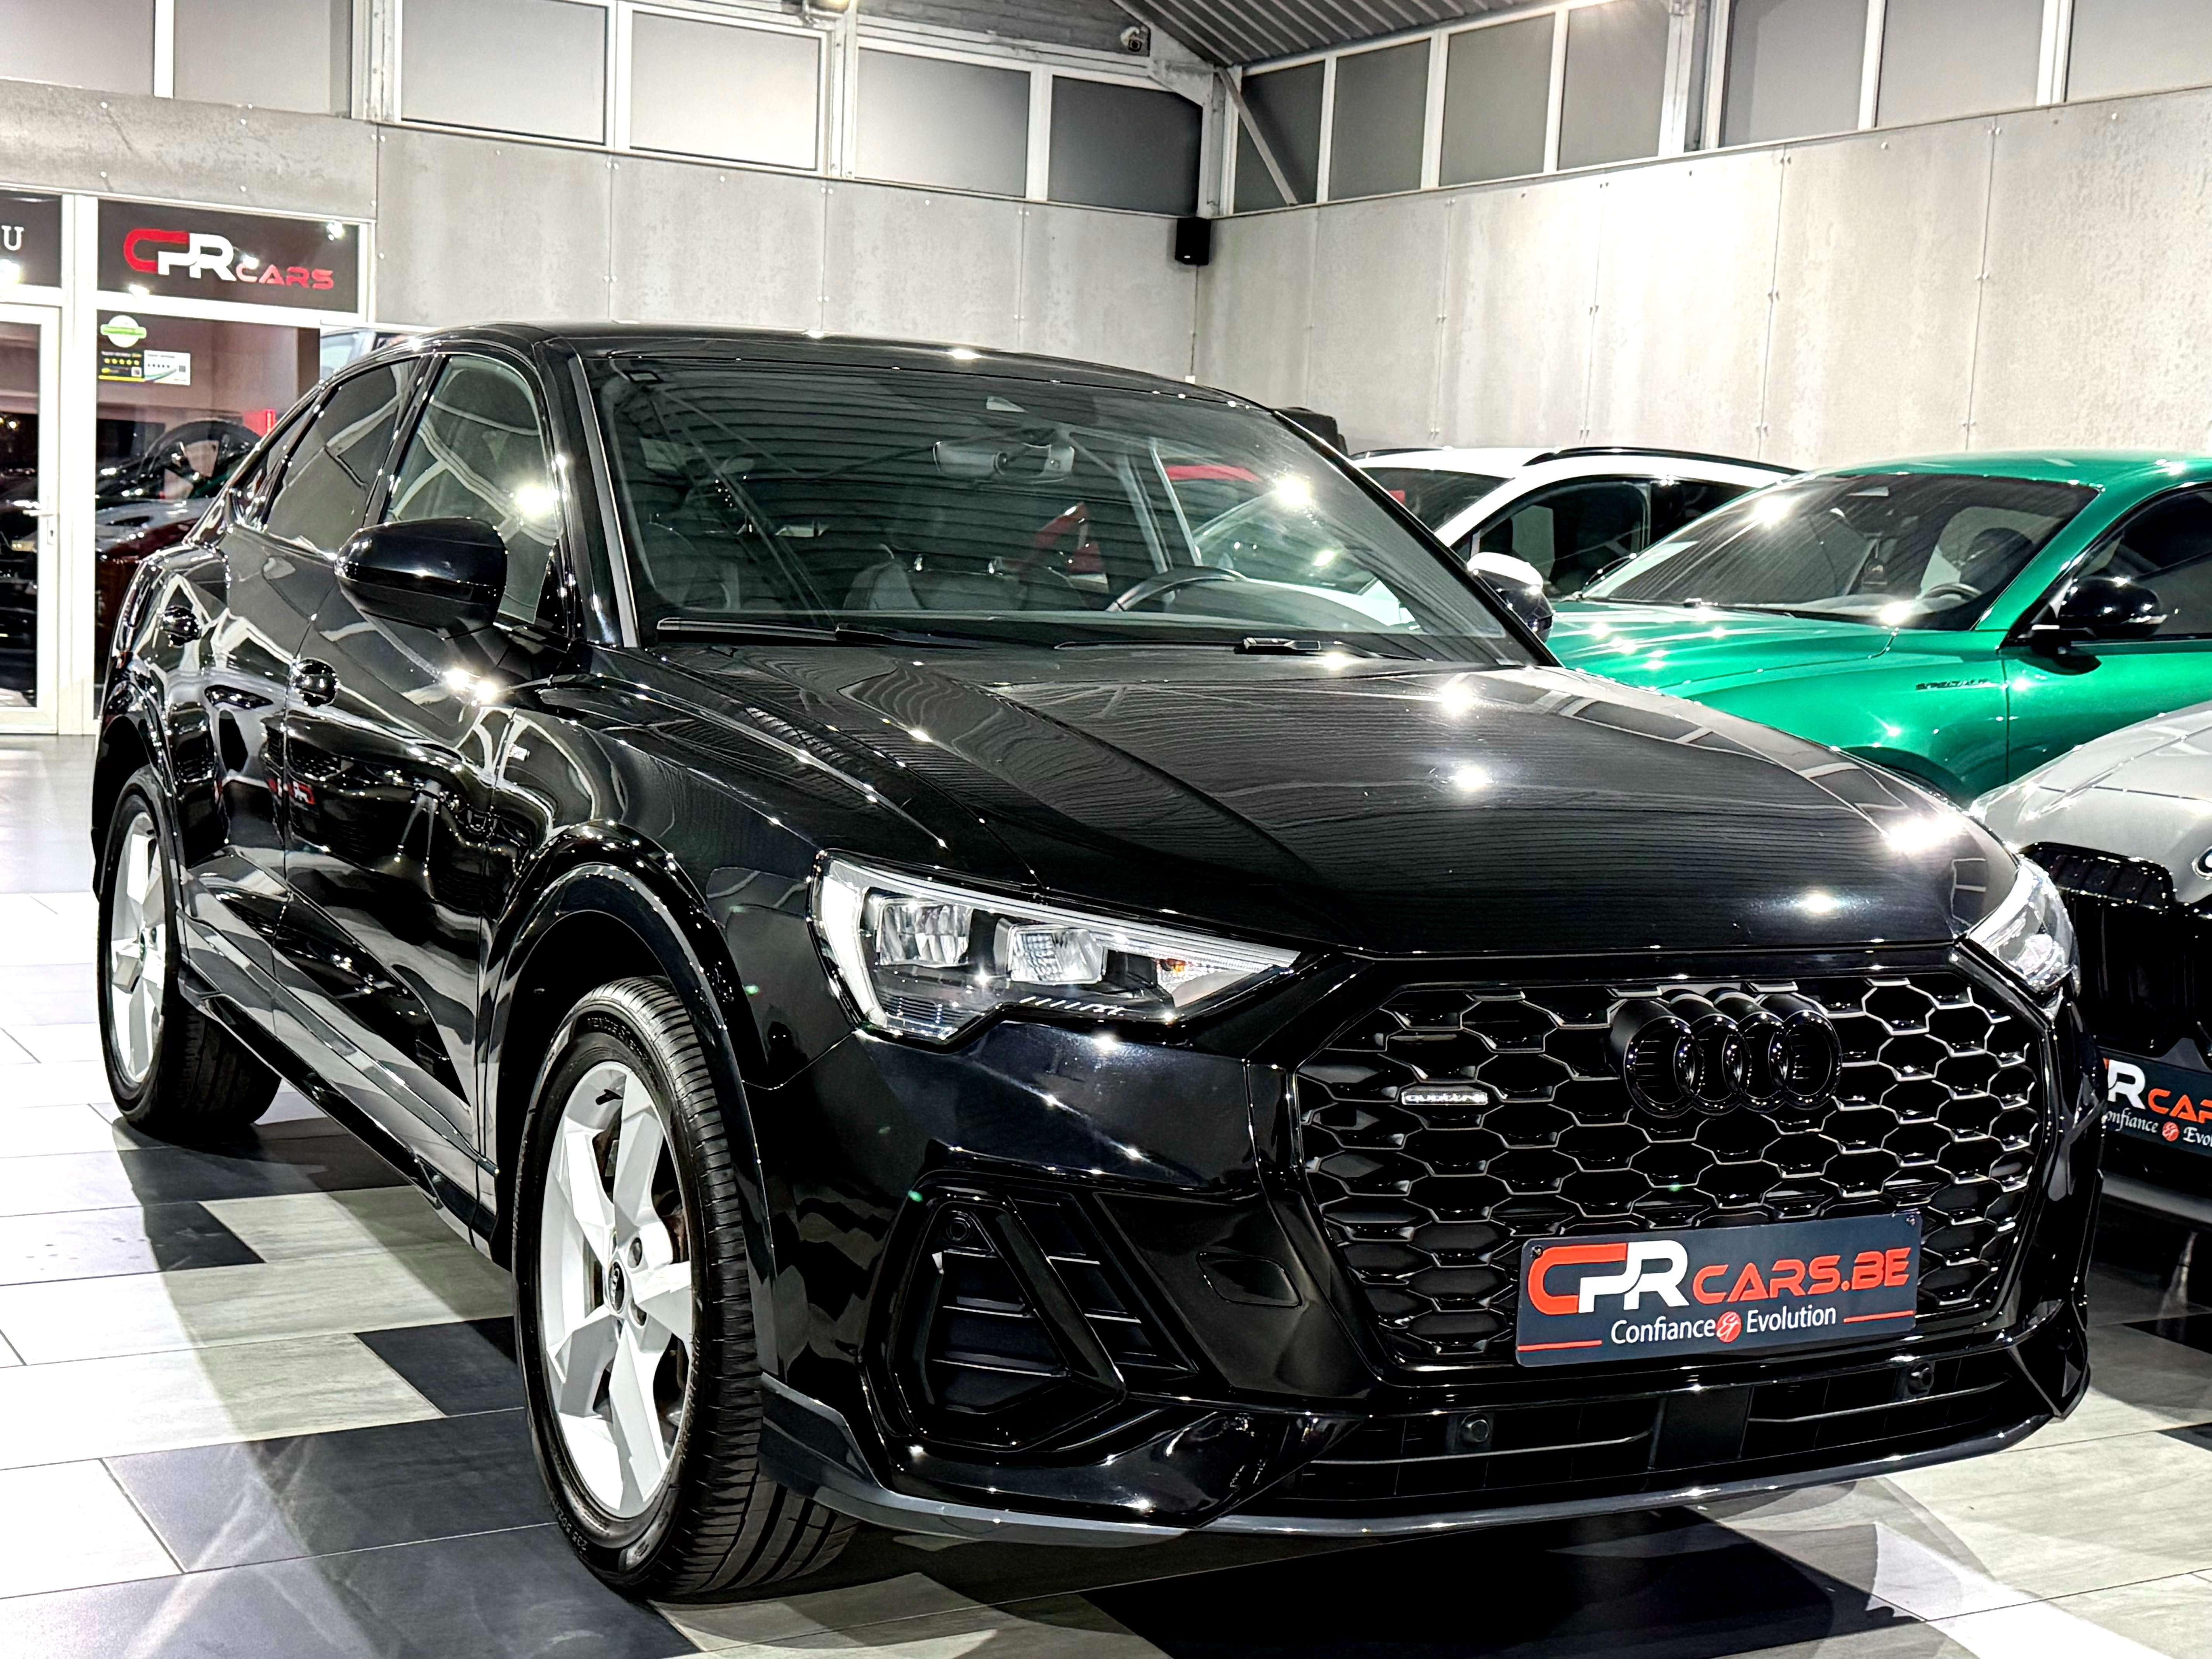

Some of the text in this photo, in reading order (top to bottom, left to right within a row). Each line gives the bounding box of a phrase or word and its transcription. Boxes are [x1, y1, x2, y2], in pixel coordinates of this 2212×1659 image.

[1, 225, 24, 251] U
[2105, 1108, 2159, 1133] onfiance
[1611, 1316, 1716, 1344] Confiance
[1746, 1304, 1836, 1333] Evolution
